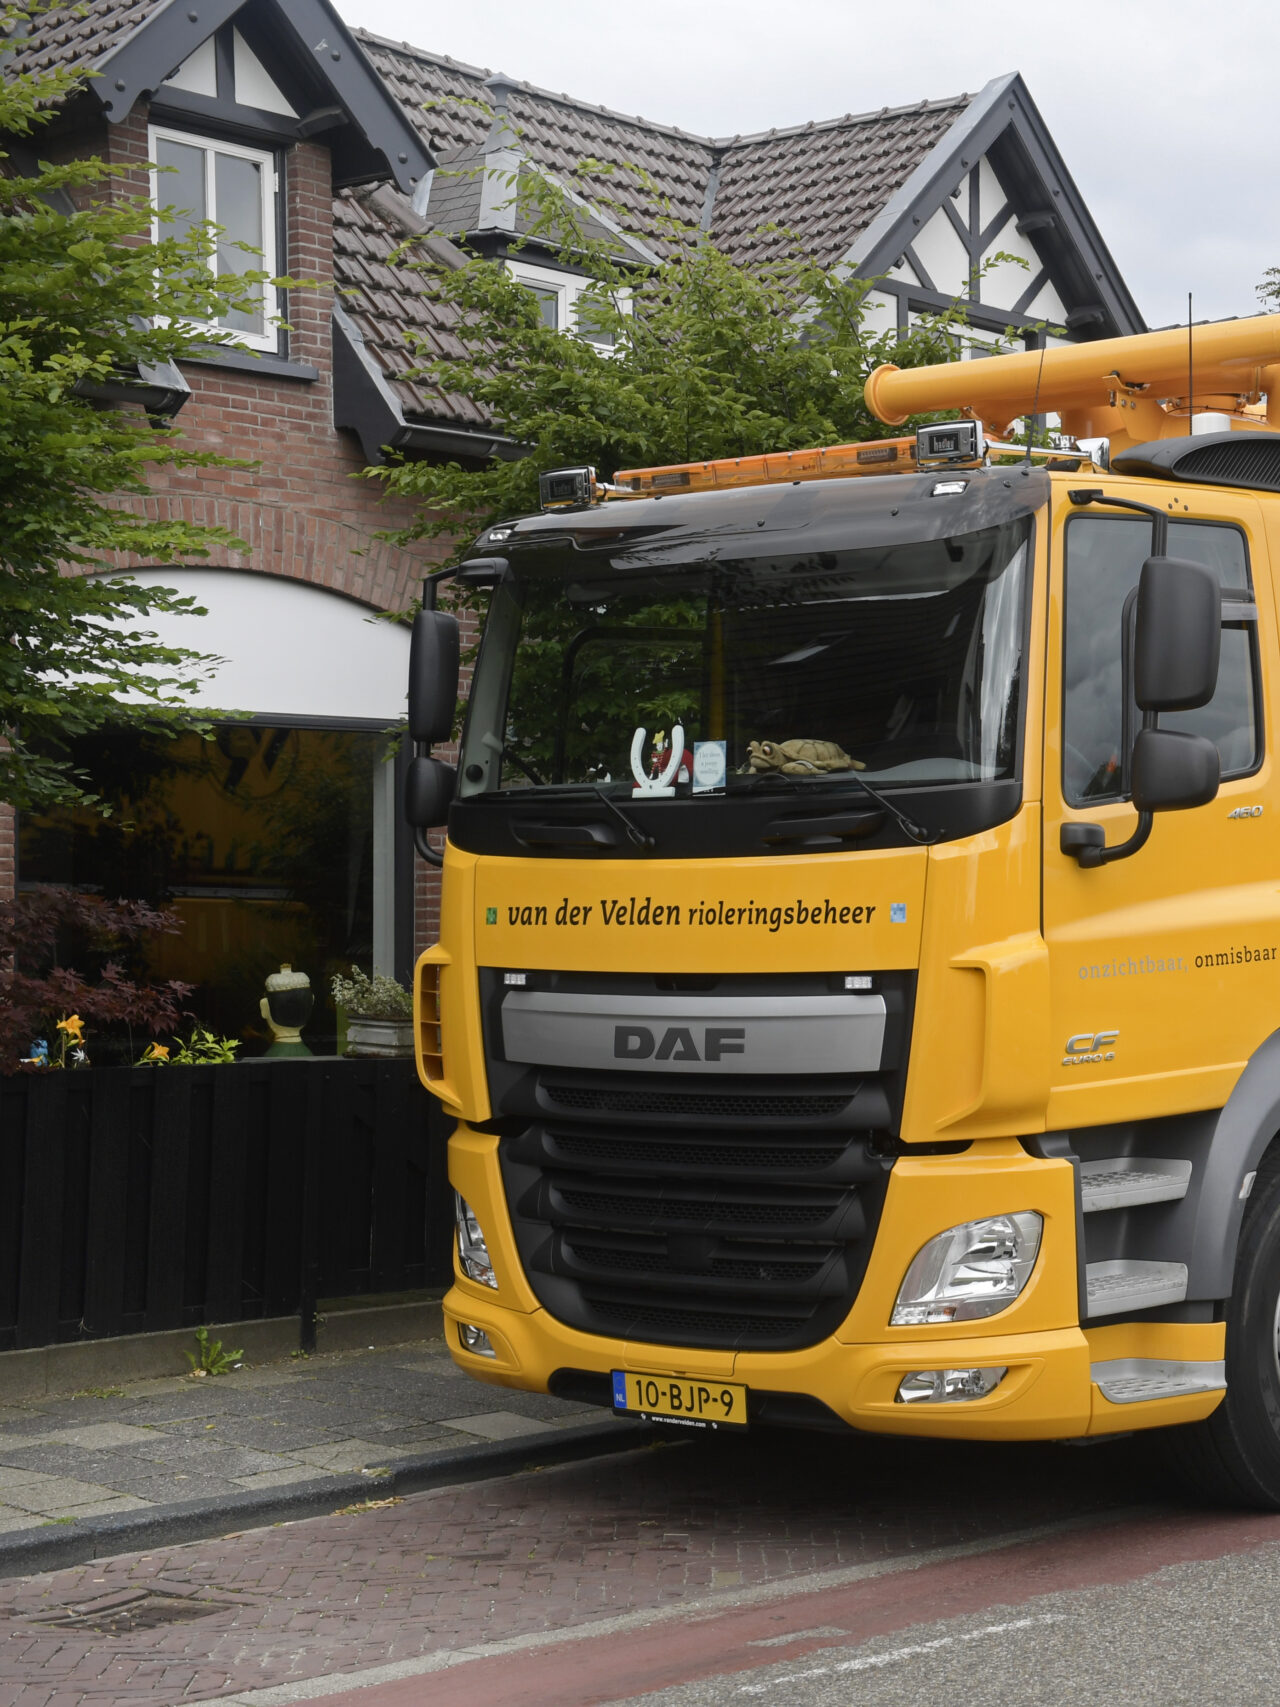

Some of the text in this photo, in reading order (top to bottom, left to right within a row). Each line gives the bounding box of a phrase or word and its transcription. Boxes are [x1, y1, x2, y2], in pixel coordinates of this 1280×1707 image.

[1227, 805, 1264, 820] 460
[507, 896, 877, 933] van der Velden rioleringsbeheer
[1194, 945, 1278, 969] onmisbaar
[613, 1025, 746, 1062] DAF
[1065, 1030, 1120, 1055] CF
[1061, 1051, 1116, 1067] EURO 6
[615, 1393, 626, 1403] NL
[635, 1379, 734, 1417] 10-BJP-9
